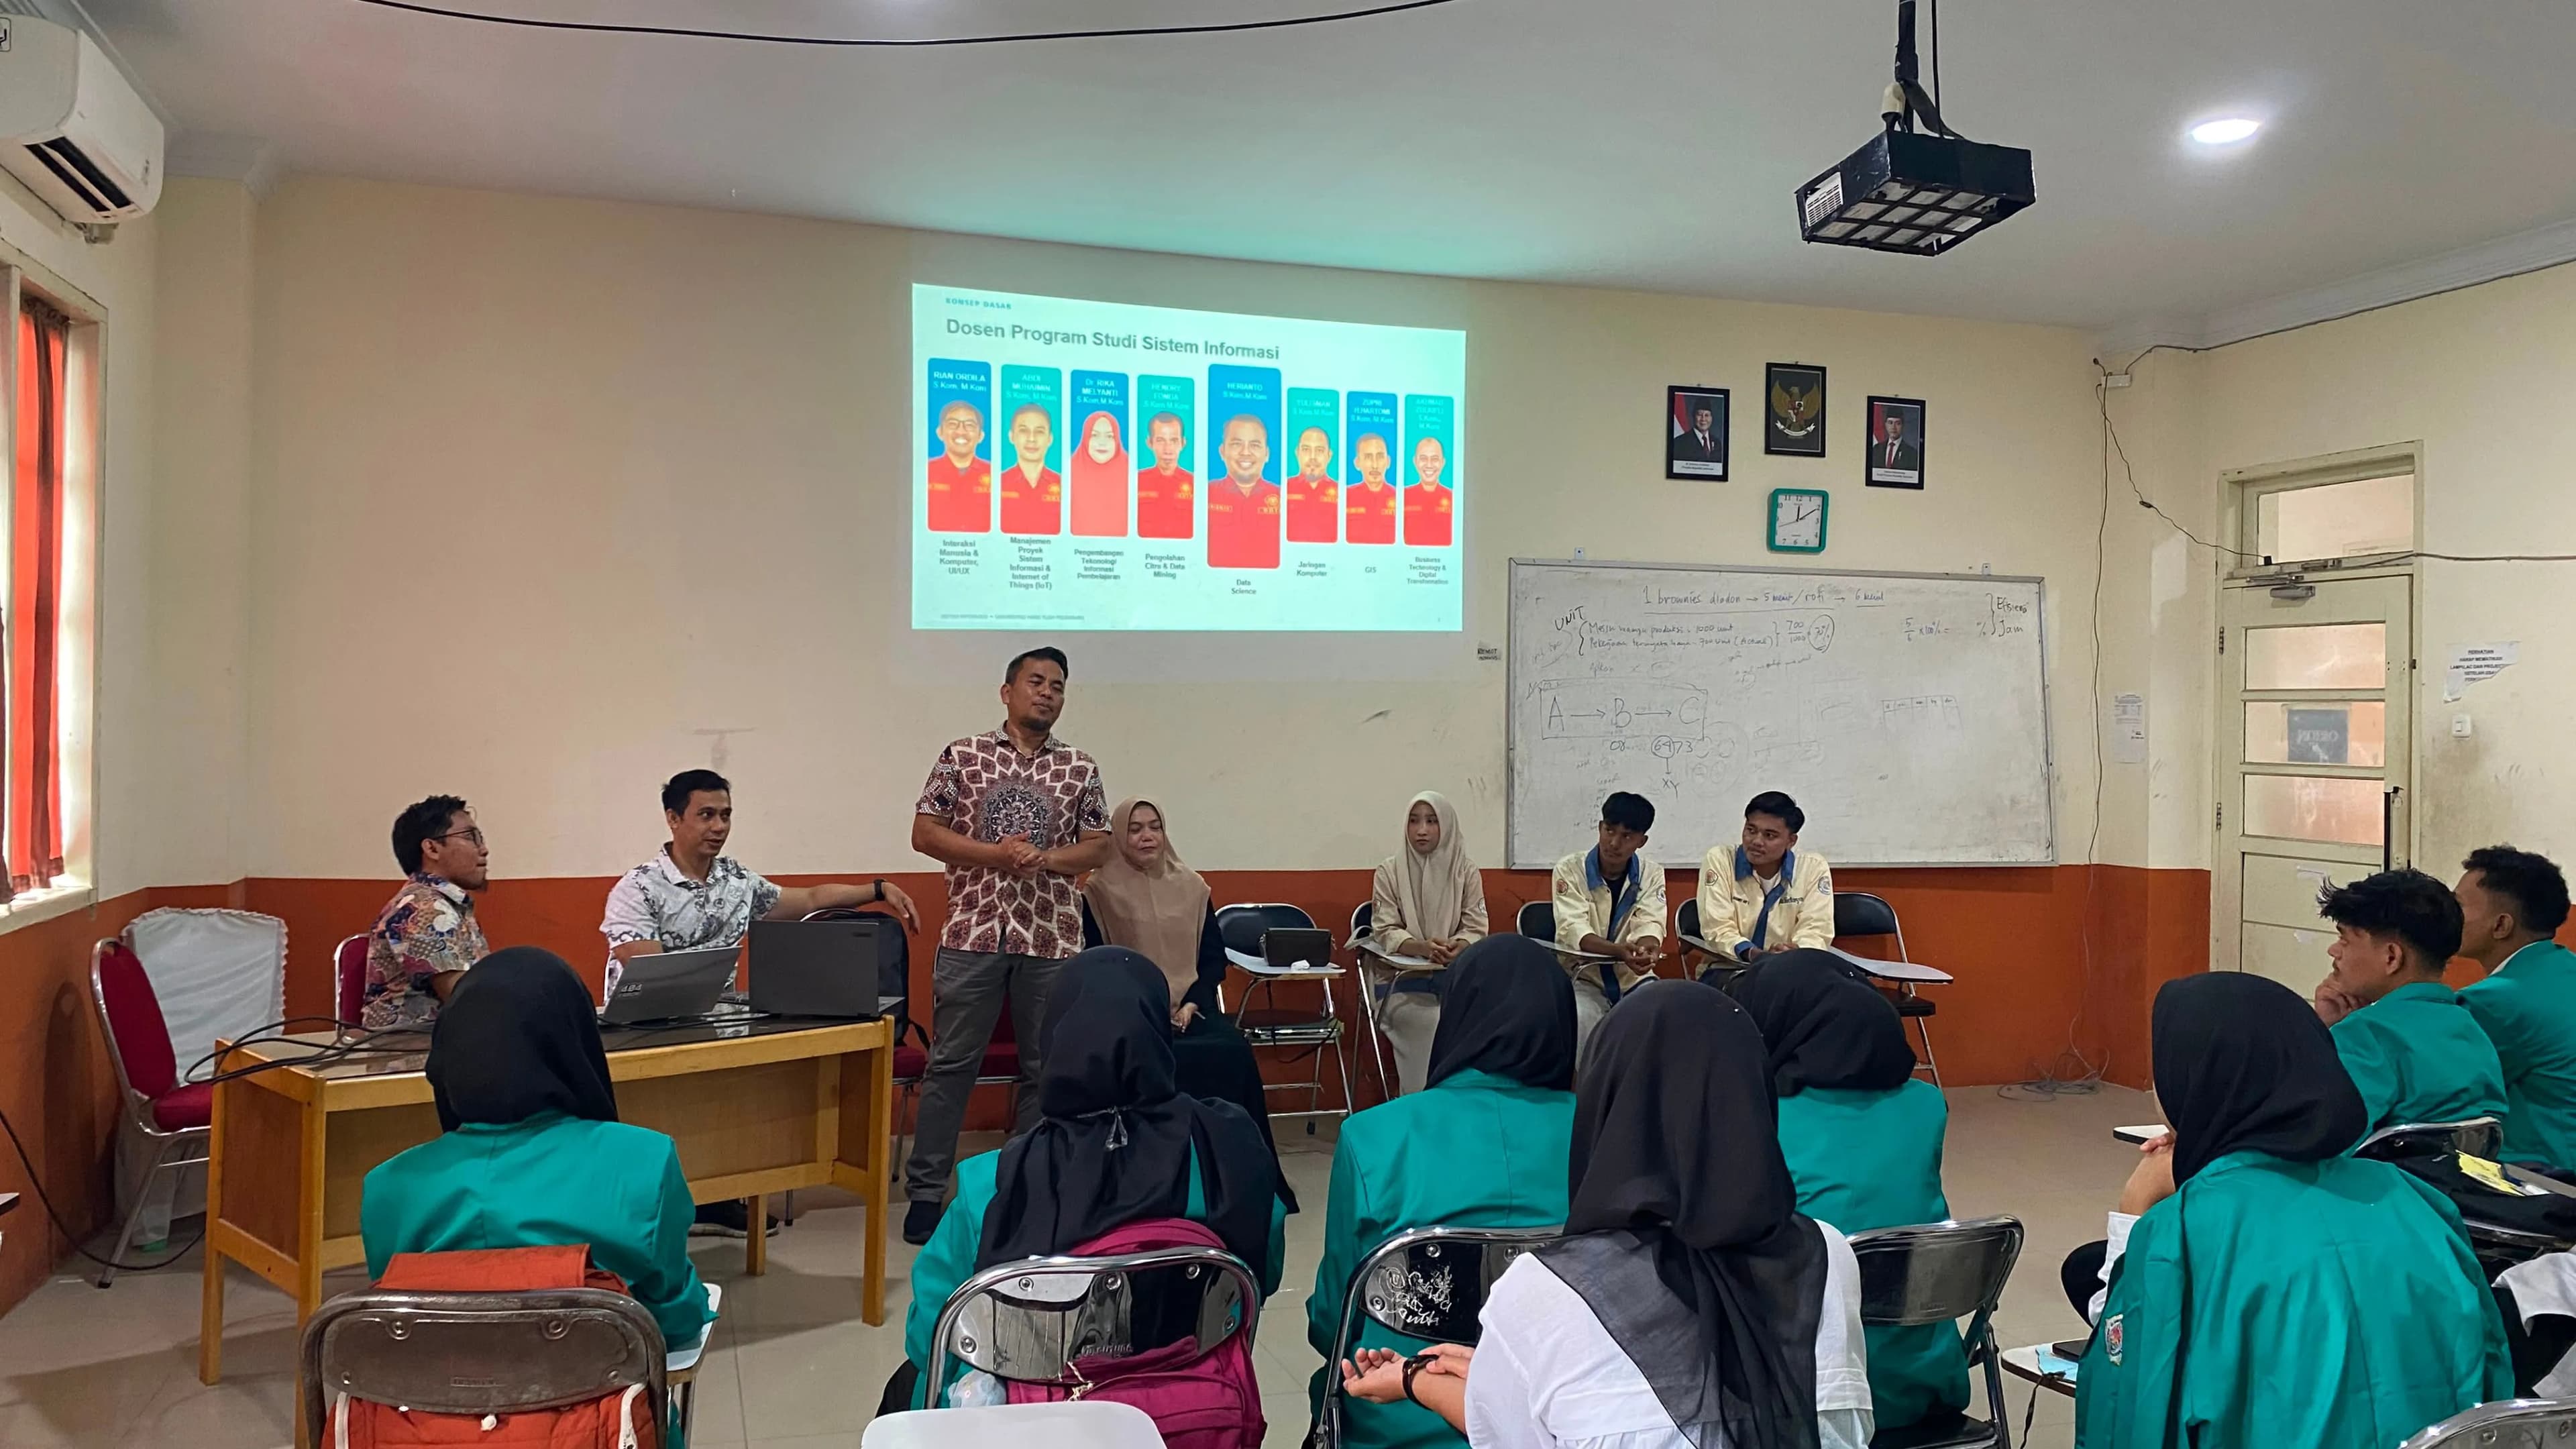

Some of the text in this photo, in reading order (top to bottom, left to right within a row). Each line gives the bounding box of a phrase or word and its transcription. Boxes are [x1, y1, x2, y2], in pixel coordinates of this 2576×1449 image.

[946, 298, 1012, 309] KONSEP DASAR
[947, 319, 1280, 360] Dosen Program Studi Sistem Informasi
[1227, 382, 1263, 391] HERIANTO
[1082, 388, 1118, 396] MELYANTI
[1010, 537, 1051, 546] Manajemen
[1018, 546, 1043, 555] Proyek
[1074, 549, 1124, 557] Pengembangan
[939, 558, 979, 566] Komputer,
[1145, 553, 1185, 562] Pengolahan
[1153, 572, 1176, 580] Mining
[1009, 581, 1052, 590] Things (IoT)
[1658, 588, 1701, 604] brownies
[1764, 592, 1770, 602] 5
[1856, 588, 1860, 600] 6
[1555, 606, 1585, 631] UNIT
[1786, 621, 1804, 630] 700
[1998, 620, 2023, 637] Jam
[1549, 696, 1700, 732] A B C
